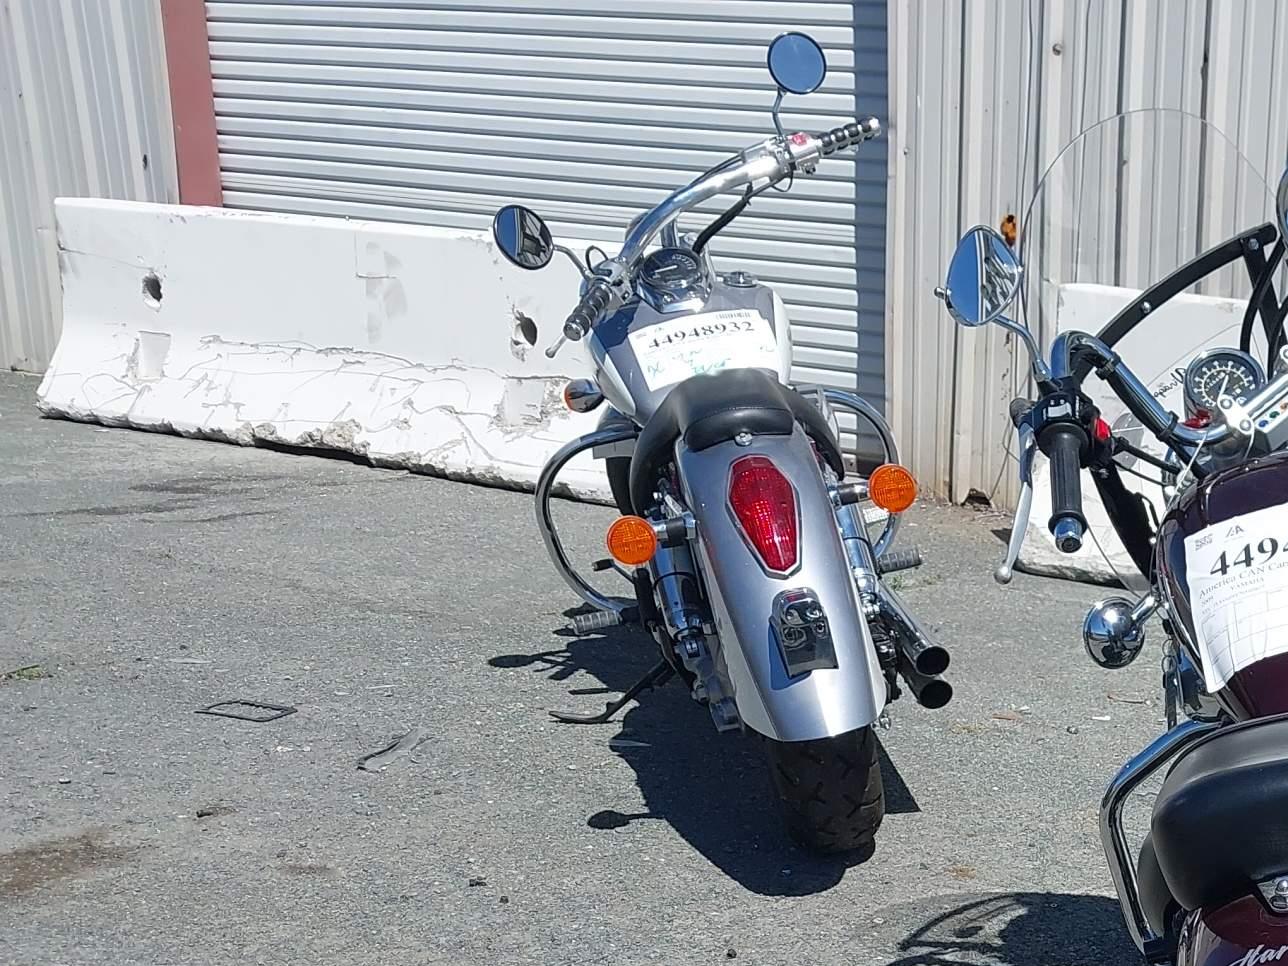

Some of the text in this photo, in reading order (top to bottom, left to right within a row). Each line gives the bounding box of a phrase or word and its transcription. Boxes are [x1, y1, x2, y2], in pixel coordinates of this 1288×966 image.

[648, 321, 755, 349] 44948932
[1199, 575, 1236, 600] America
[1239, 565, 1264, 579] CAN
